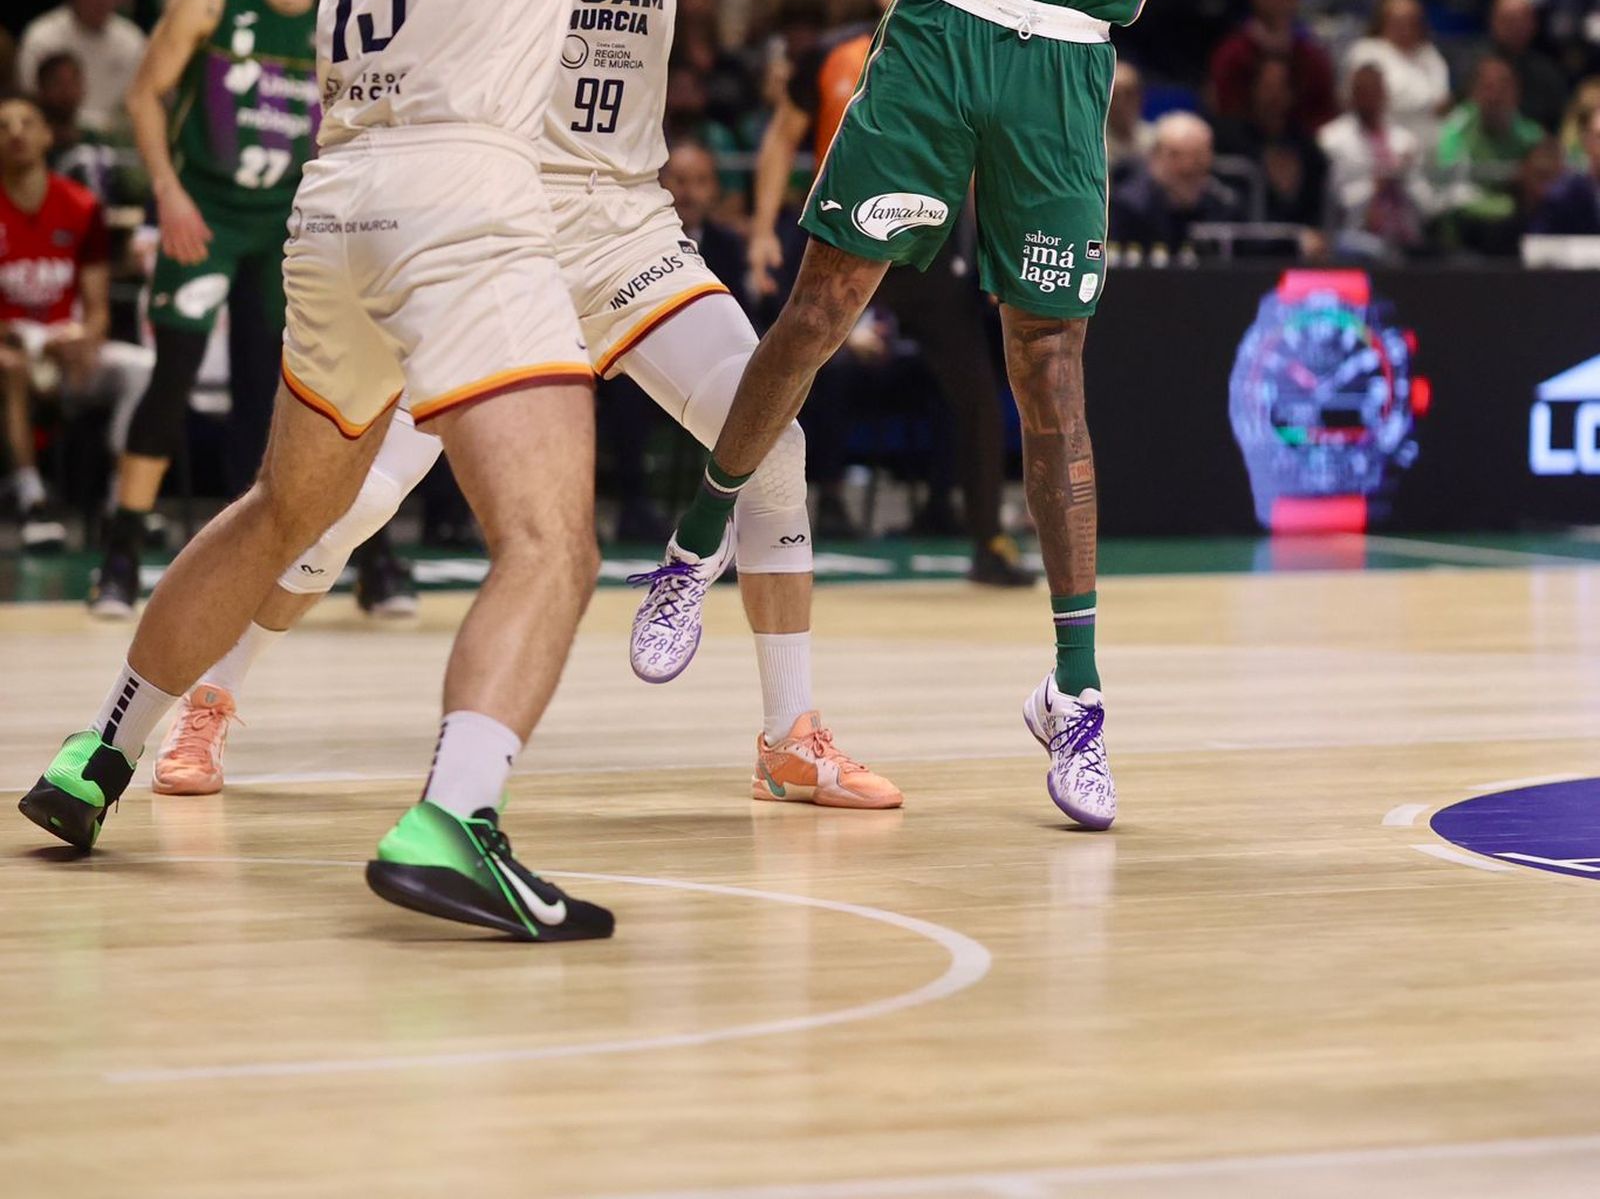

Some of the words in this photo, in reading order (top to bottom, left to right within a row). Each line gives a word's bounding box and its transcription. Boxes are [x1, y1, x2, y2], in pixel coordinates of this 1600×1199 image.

[593, 58, 607, 68] DE
[609, 59, 644, 70] MURCIA
[570, 77, 625, 134] 99
[234, 145, 292, 189] 27
[859, 195, 945, 225] famadesa
[344, 222, 358, 233] DE
[359, 218, 399, 232] MURCIA
[1024, 230, 1062, 247] sabor
[1022, 244, 1031, 255] a
[610, 255, 685, 311] INVERSUS
[1018, 257, 1071, 293] laga
